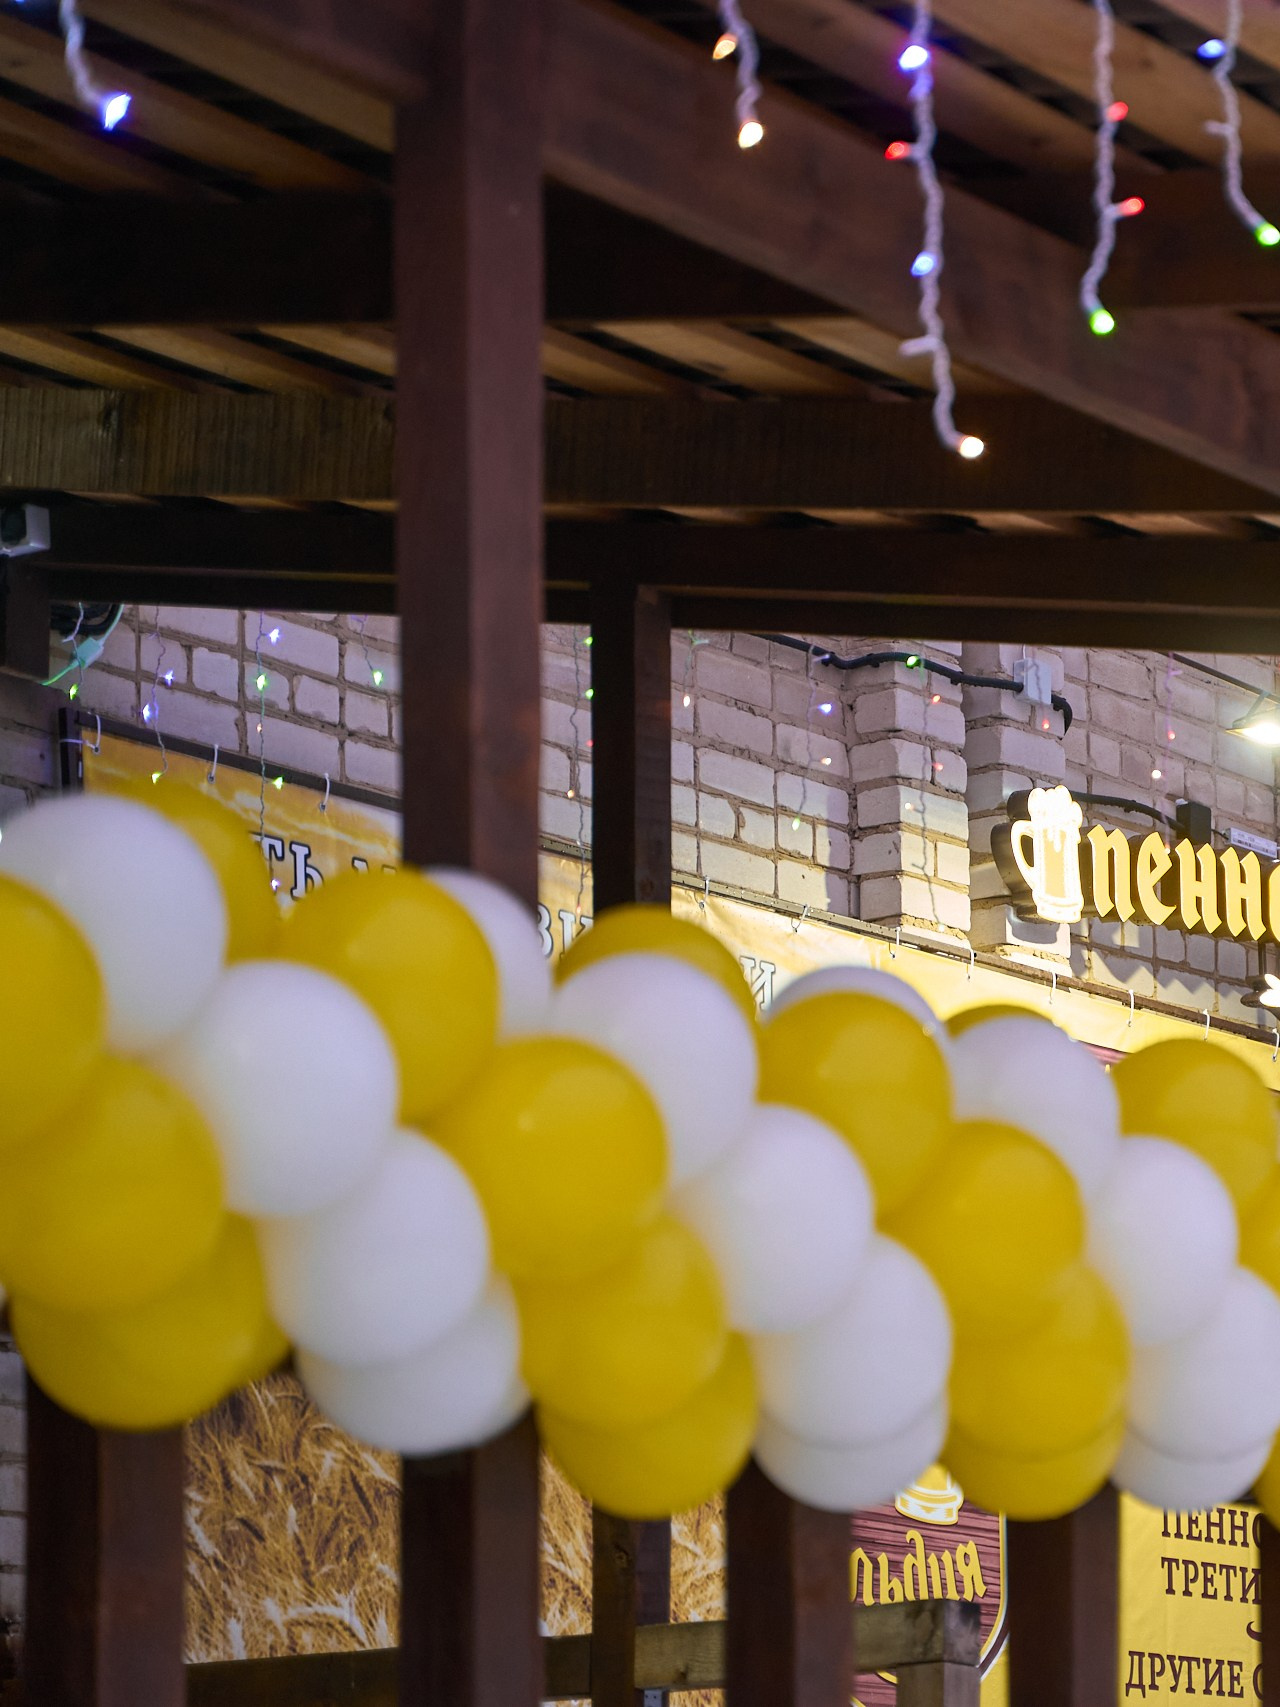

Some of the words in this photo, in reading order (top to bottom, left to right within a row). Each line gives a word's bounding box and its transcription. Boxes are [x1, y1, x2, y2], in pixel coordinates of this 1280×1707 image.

[850, 1529, 987, 1606] льдия
[1161, 1556, 1263, 1605] ТРЕТИ
[1125, 1650, 1244, 1698] ДРУГИЕ
